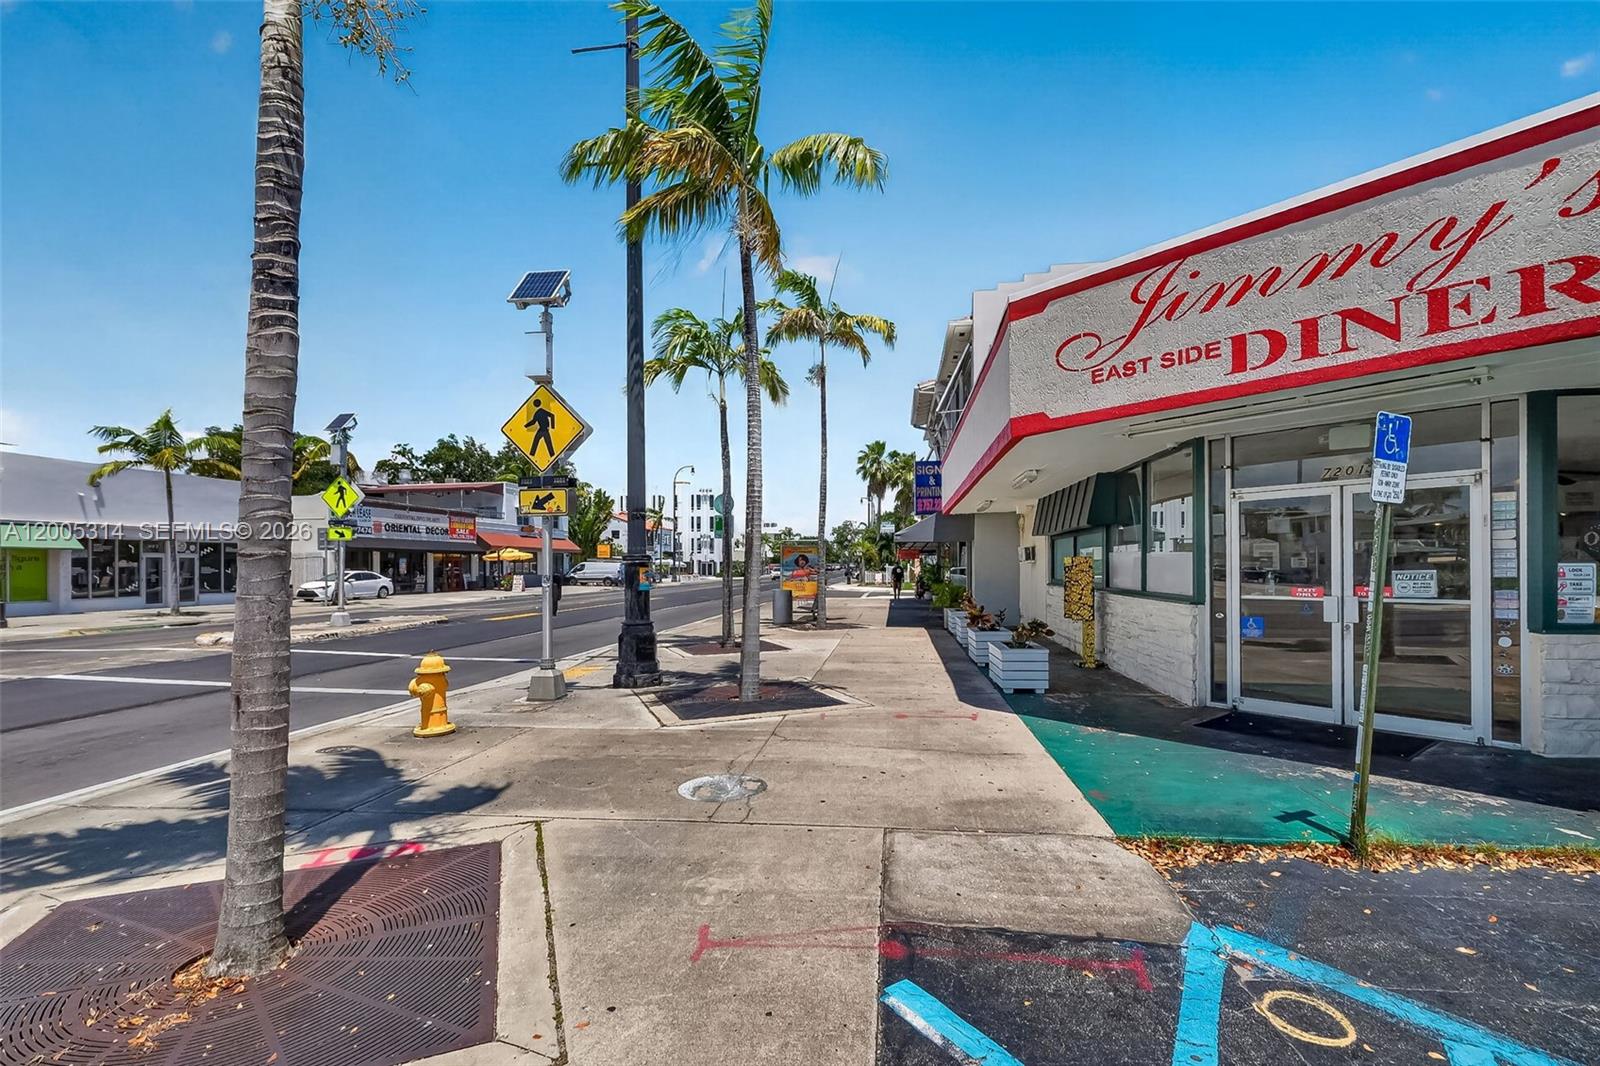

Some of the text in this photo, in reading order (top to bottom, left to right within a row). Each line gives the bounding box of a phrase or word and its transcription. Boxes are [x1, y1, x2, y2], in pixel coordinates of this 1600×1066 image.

[1056, 157, 1600, 372] Jimmy's
[1091, 256, 1600, 385] EAST SIDE DINER
[929, 475, 936, 485] &
[384, 522, 449, 536] ORIENTAL DECOR
